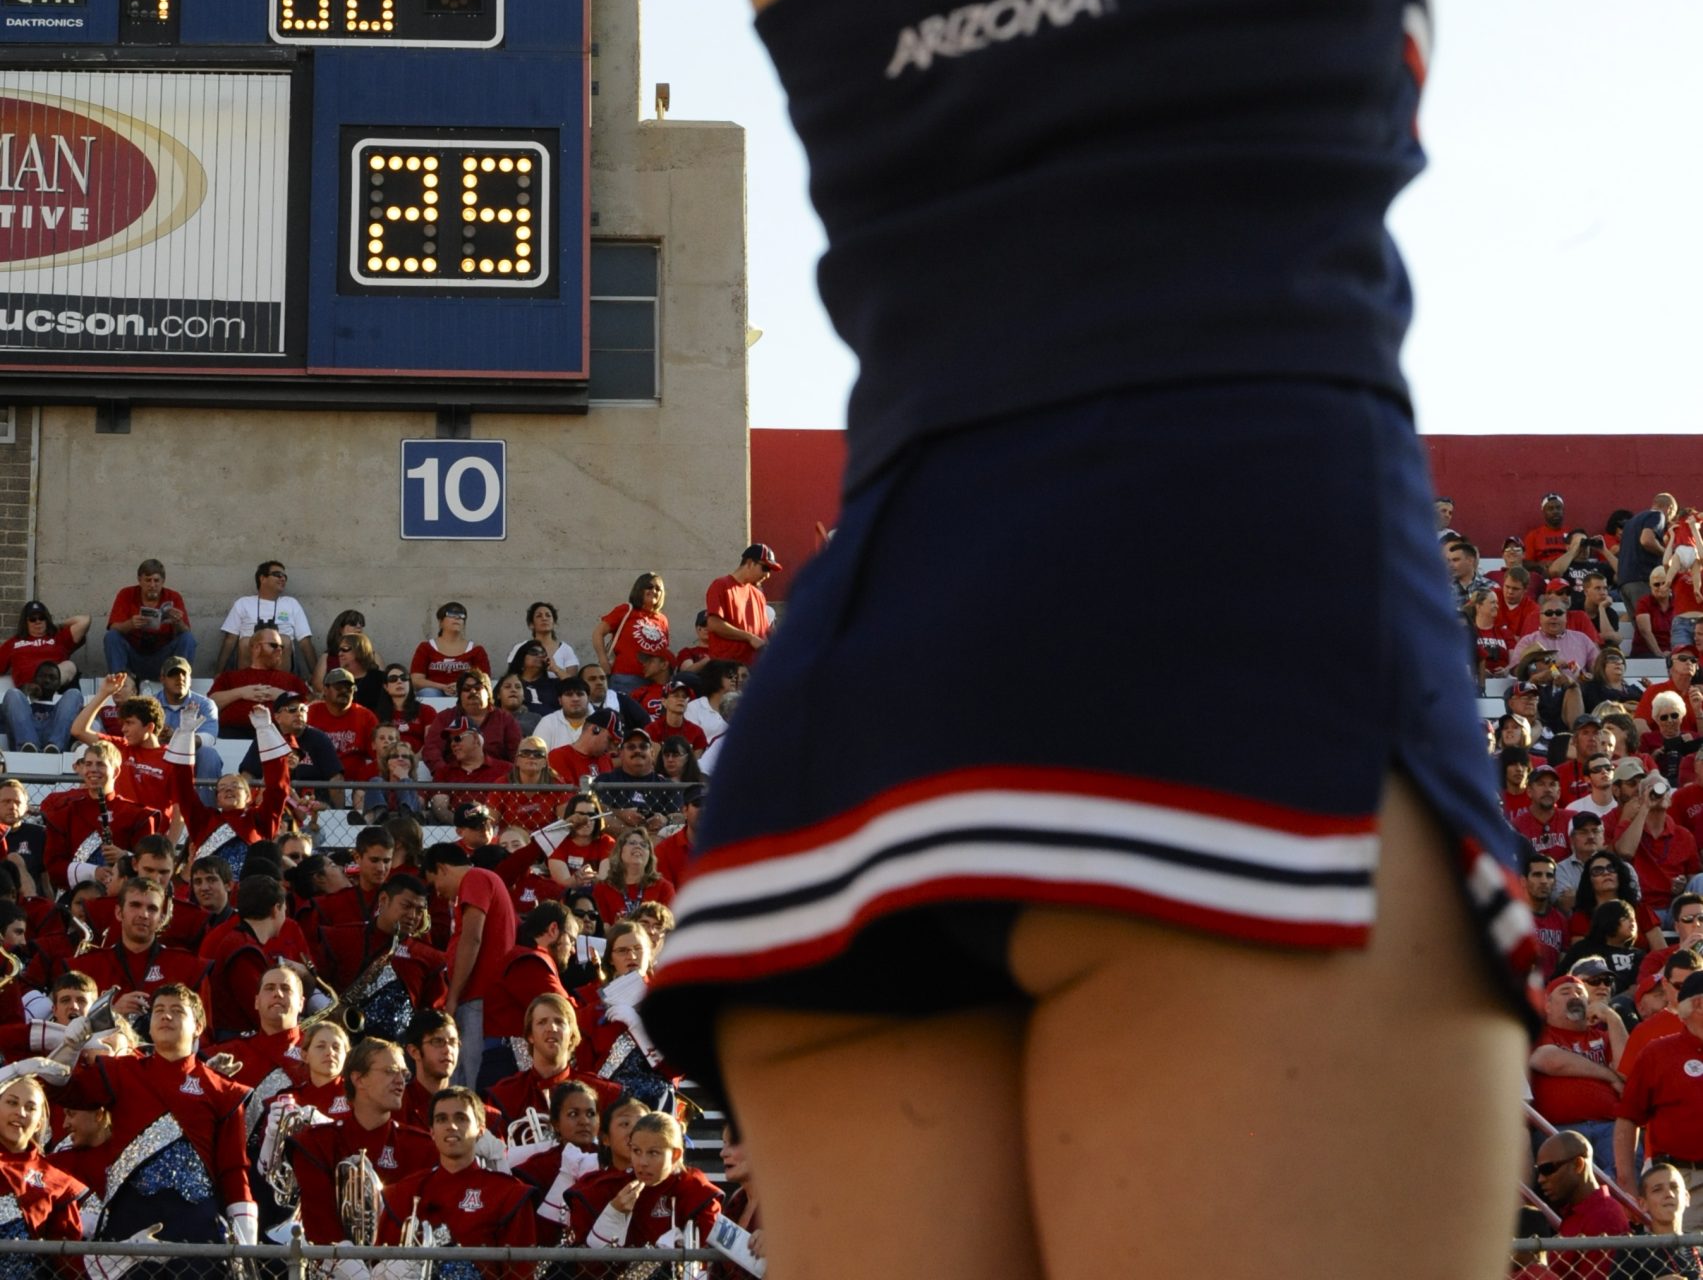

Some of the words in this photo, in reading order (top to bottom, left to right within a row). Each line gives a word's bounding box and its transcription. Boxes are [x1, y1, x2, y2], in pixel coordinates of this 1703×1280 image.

[6, 18, 84, 27] DAKTRONICS
[366, 155, 532, 273] 25
[0, 309, 245, 339] ucson.com
[406, 456, 502, 523] 10
